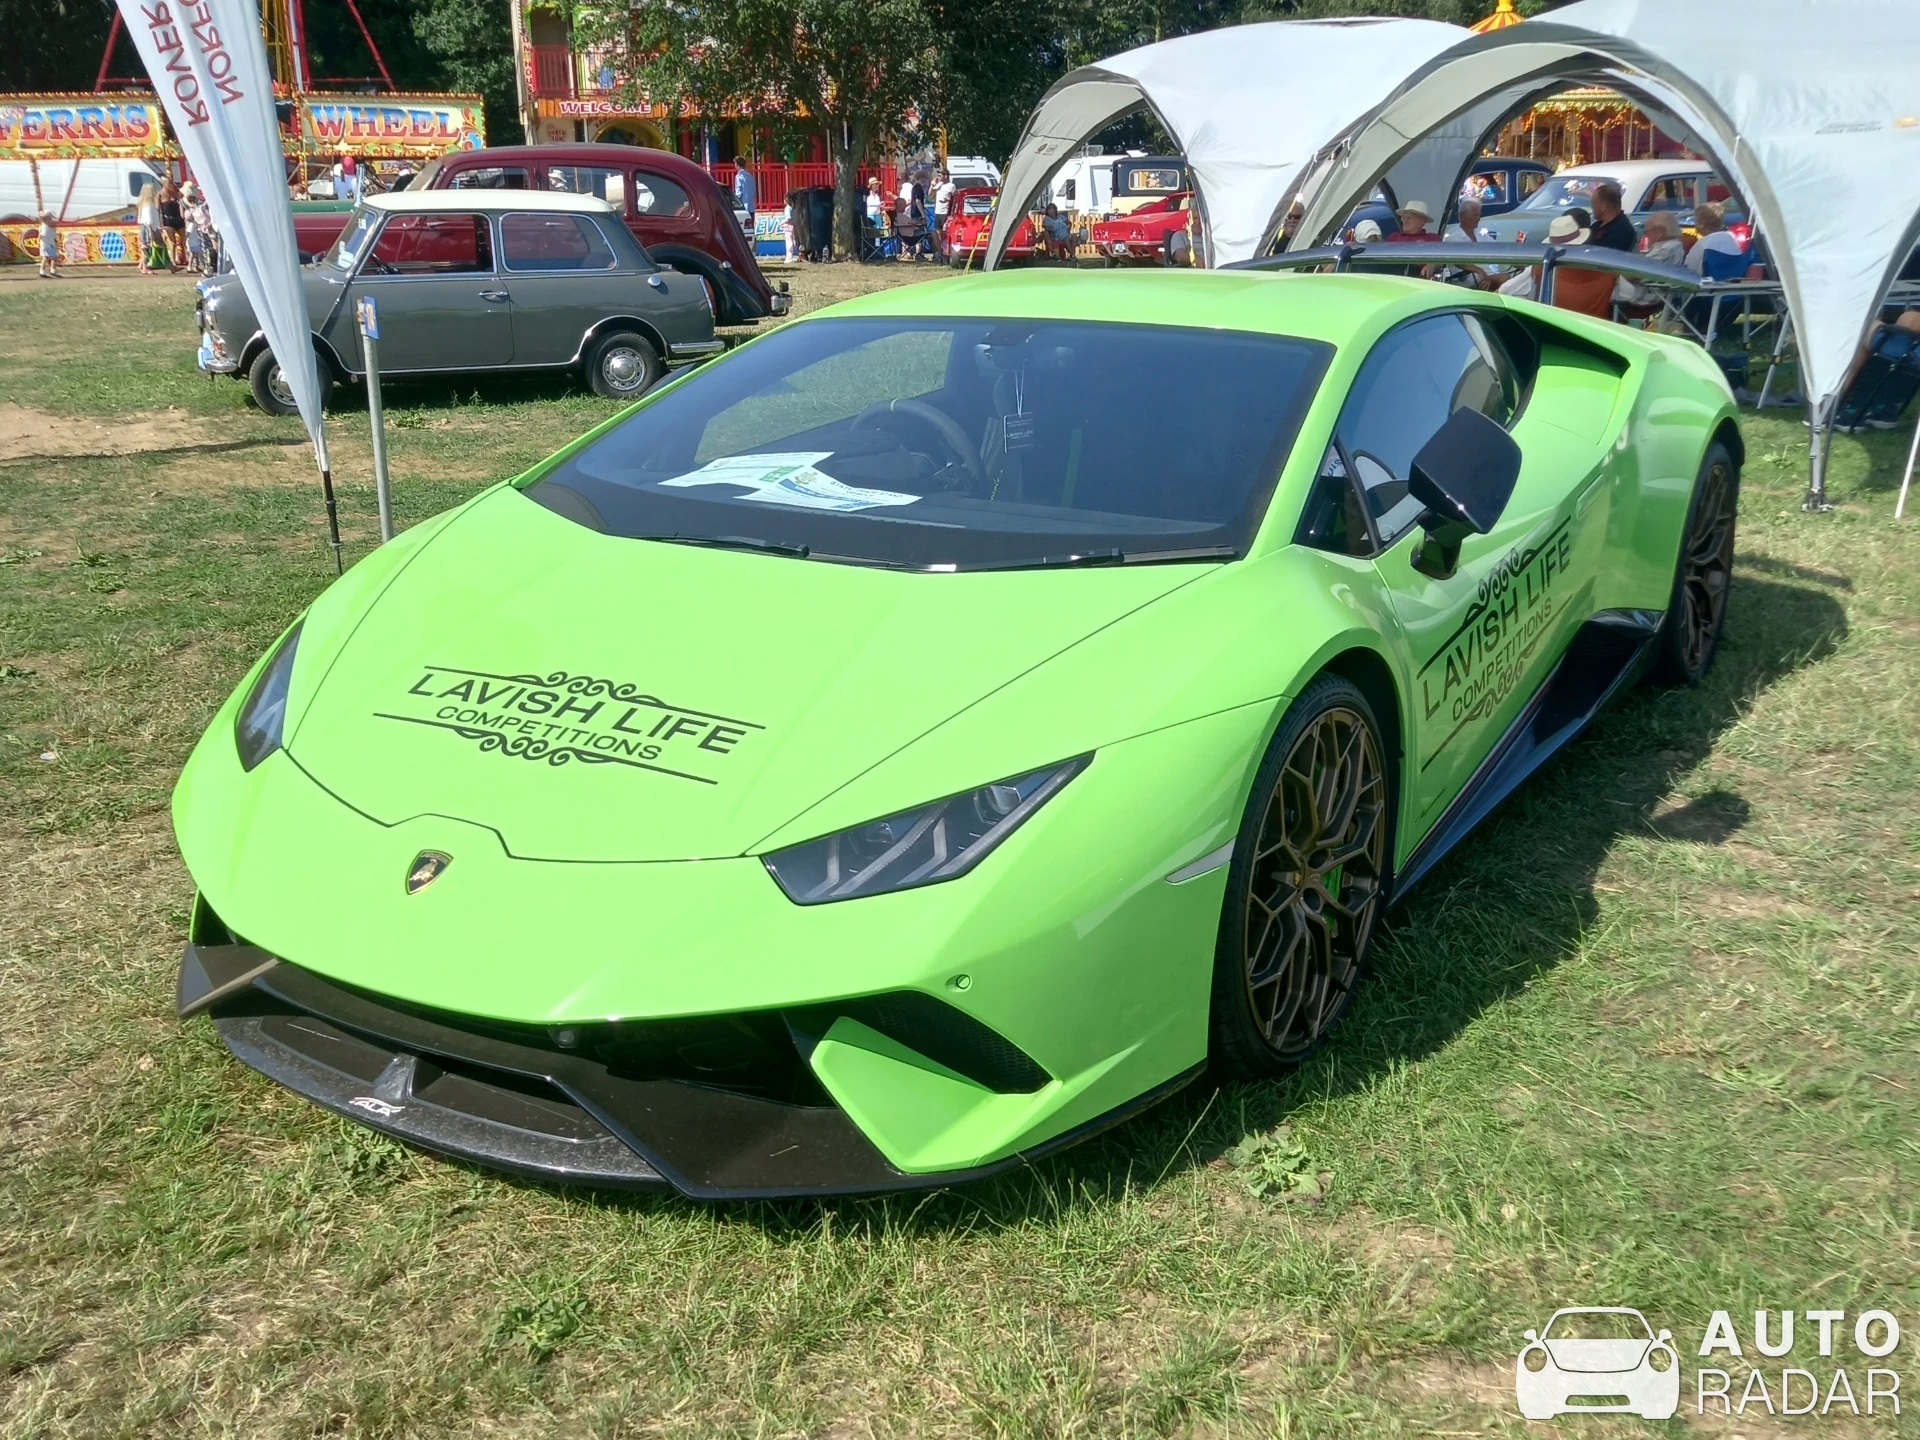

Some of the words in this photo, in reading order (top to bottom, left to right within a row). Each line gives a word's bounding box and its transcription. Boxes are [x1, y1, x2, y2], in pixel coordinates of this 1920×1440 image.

[310, 105, 462, 140] WHEEL
[559, 101, 652, 114] WELCOME
[1422, 586, 1519, 722] LAVISH
[1526, 530, 1570, 611] LIFE
[1452, 597, 1552, 722] COMPETITIONS
[408, 673, 606, 724] LAVISH
[612, 707, 748, 755] LIFE
[435, 706, 663, 760] COMPETITIONS
